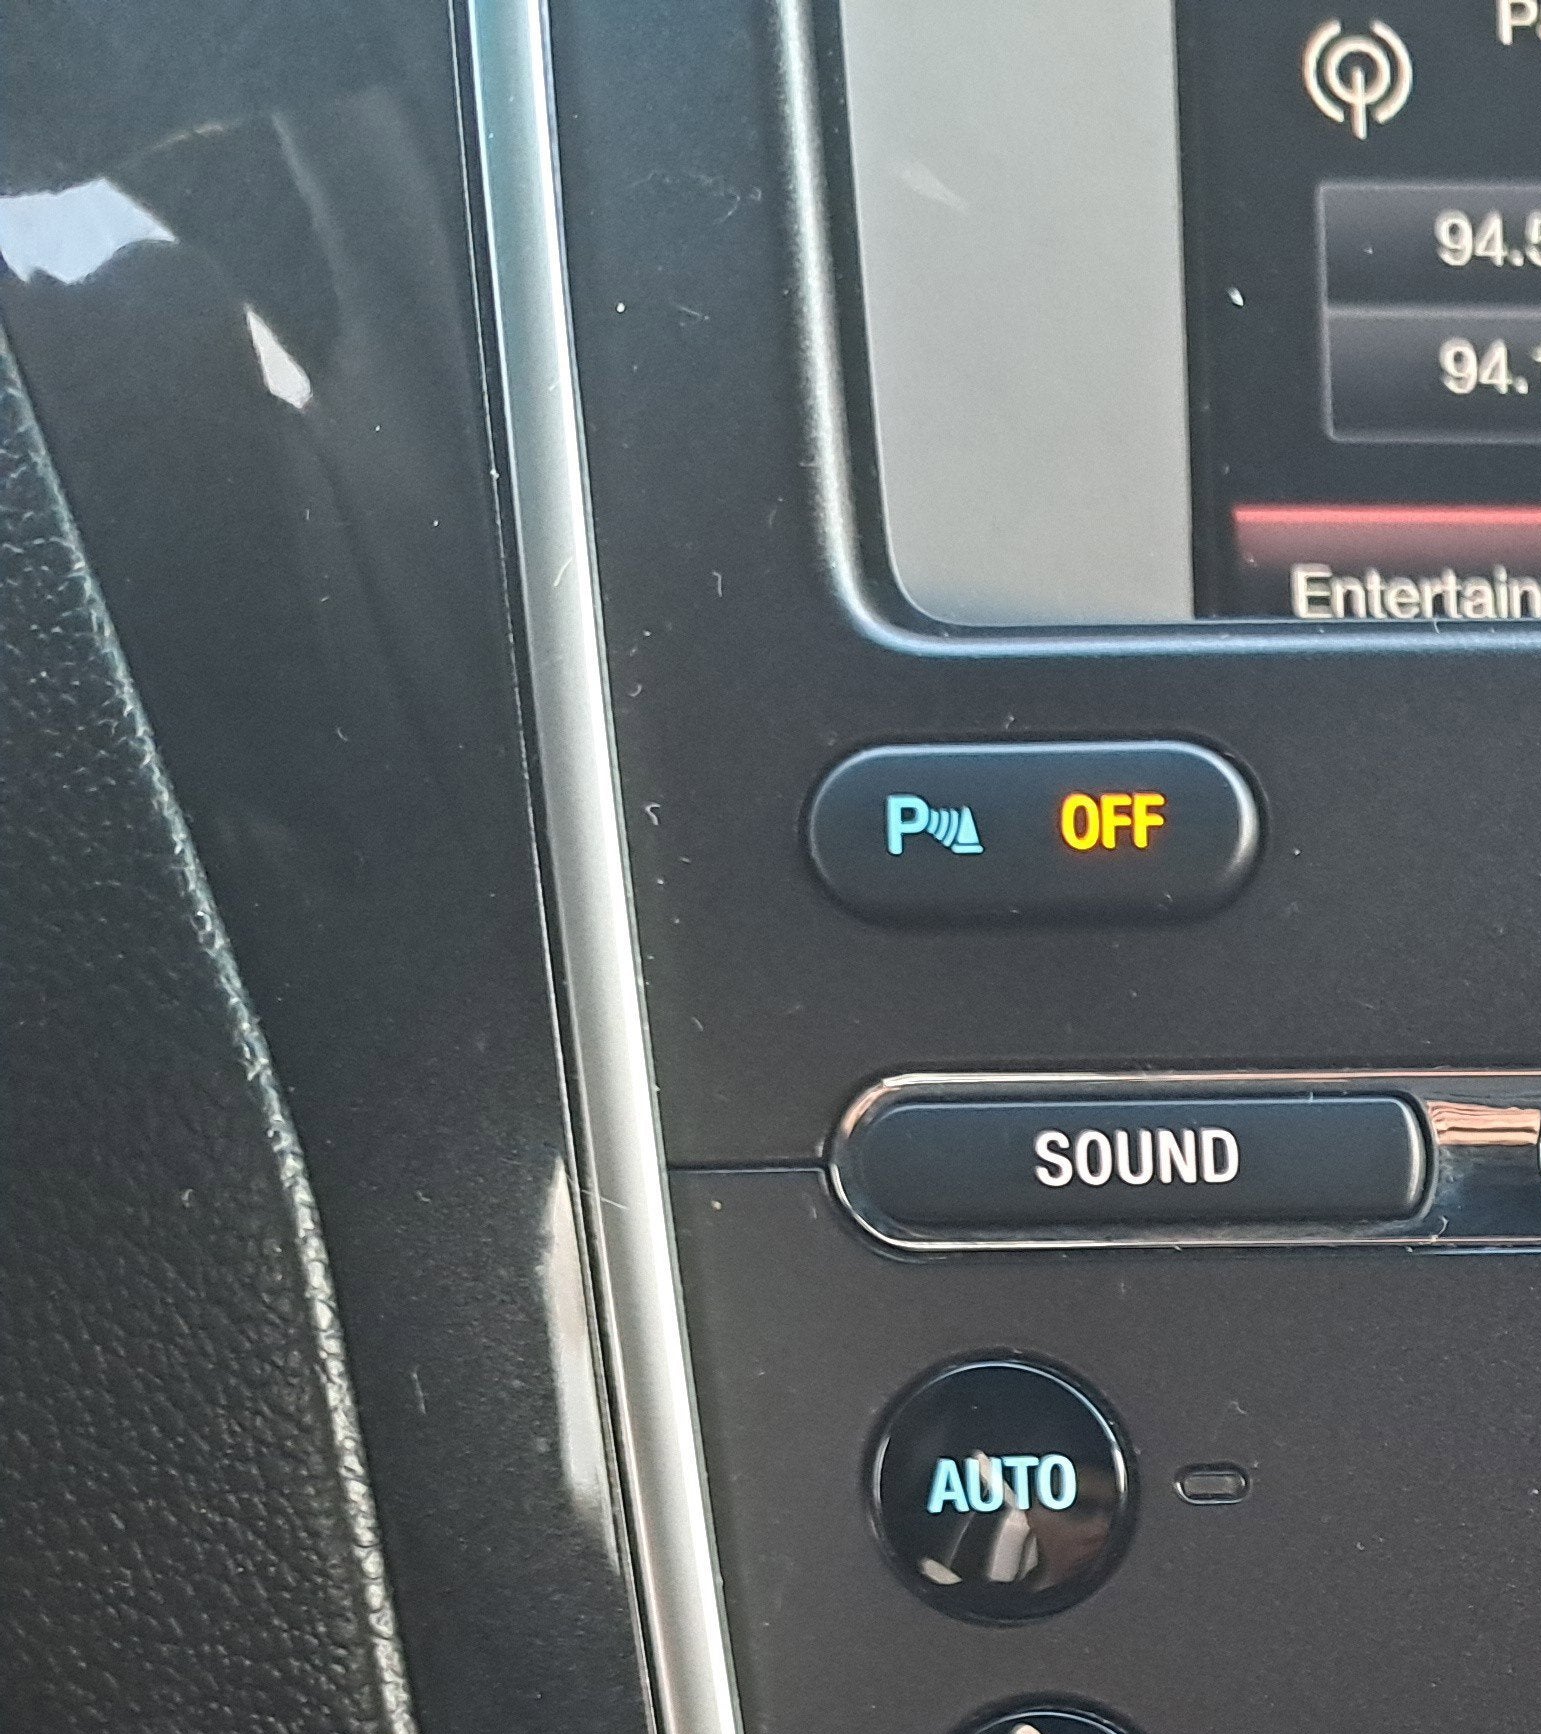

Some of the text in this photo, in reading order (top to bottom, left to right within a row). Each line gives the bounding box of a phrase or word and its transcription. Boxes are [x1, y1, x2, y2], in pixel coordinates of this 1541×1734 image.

[1060, 792, 1165, 850] OFF
[1034, 1128, 1241, 1188] SOUND
[926, 1453, 1078, 1514] AUTO
